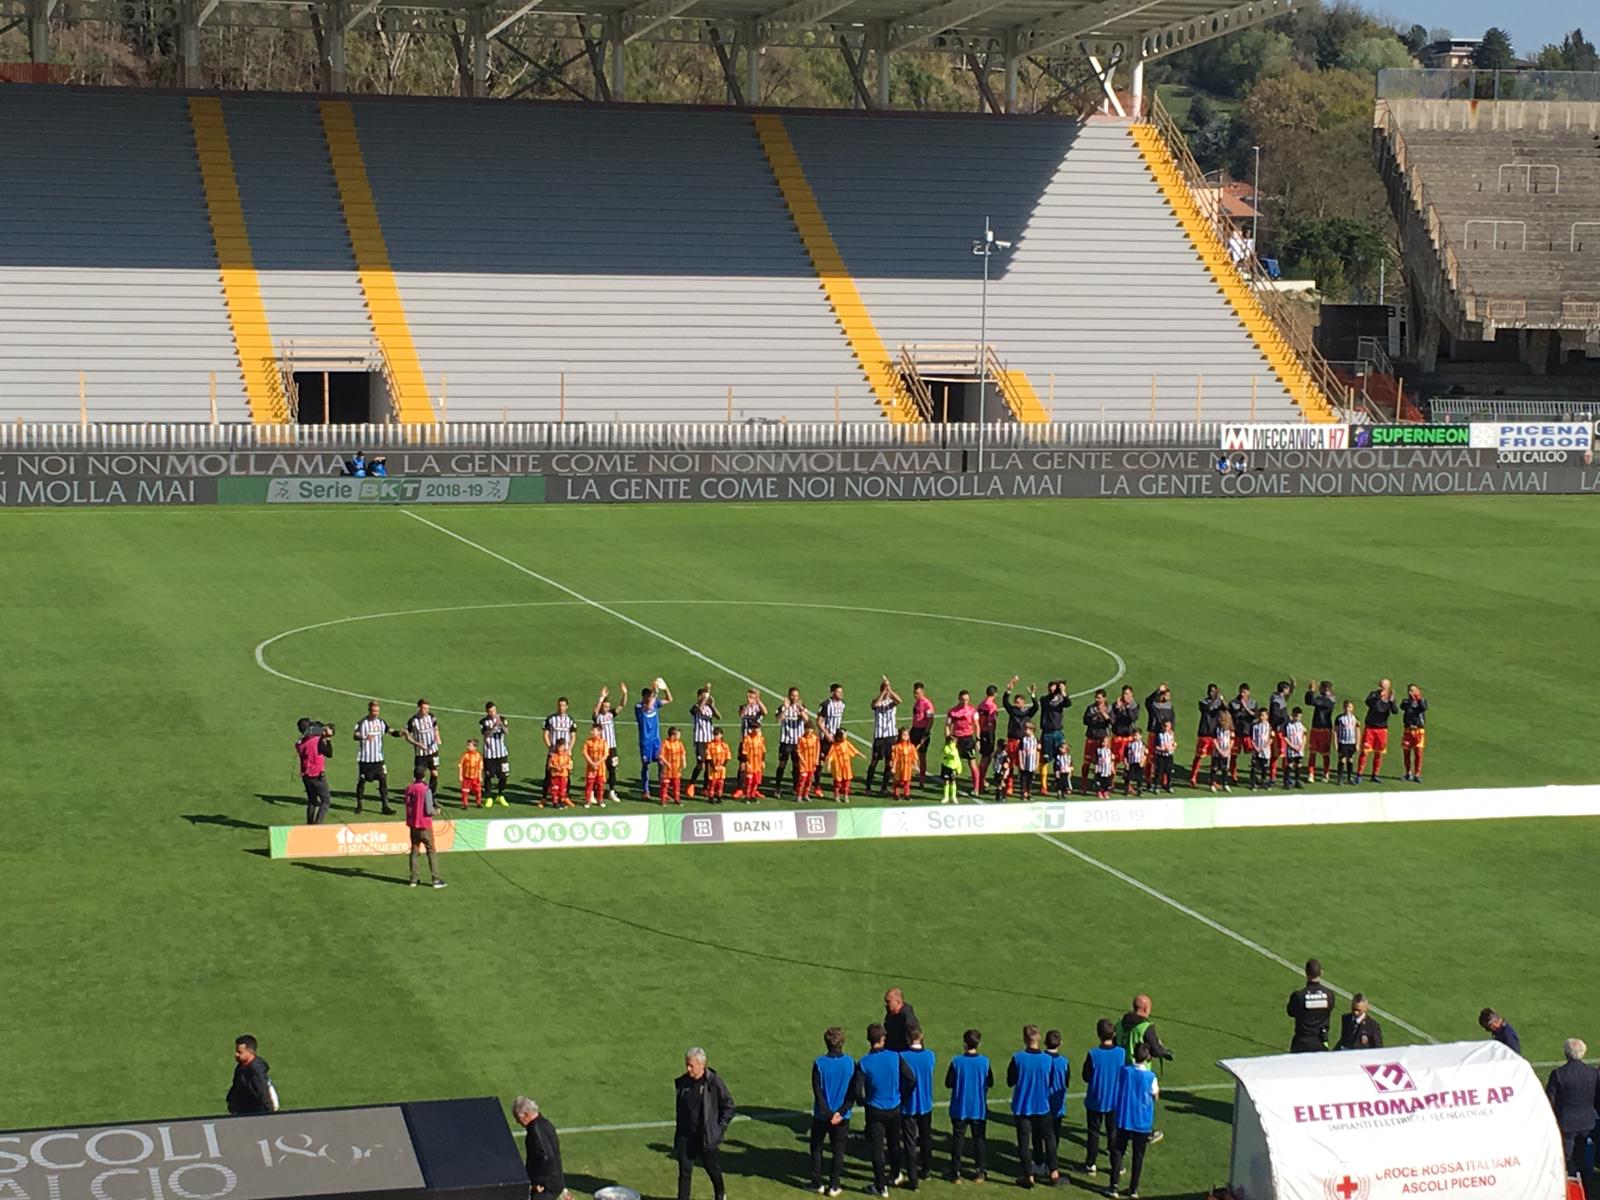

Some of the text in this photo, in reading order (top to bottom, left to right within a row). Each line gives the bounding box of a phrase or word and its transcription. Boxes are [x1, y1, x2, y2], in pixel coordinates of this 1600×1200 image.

[1253, 428, 1346, 449] MECCANICA H7
[1372, 428, 1469, 443] SUPERNEON
[1500, 426, 1588, 435] PICENA
[1500, 437, 1589, 447] FRIGOR
[17, 455, 76, 475] NOI
[403, 454, 441, 473] LA
[450, 454, 542, 473] GENTE
[551, 453, 638, 473] COME
[648, 453, 701, 472] NOI
[990, 452, 1024, 470] LA
[1031, 451, 1113, 470] GENTE
[1122, 451, 1198, 470] COME
[1522, 451, 1567, 463] CALCIO
[17, 480, 128, 503] MOLLA
[136, 480, 195, 502] MAI
[299, 479, 483, 501] Serie BKT 2018-19
[566, 475, 1062, 500] LA GENTE COME NOI NON MOLLA MAI
[1100, 471, 1549, 495] LA GENTE COME NOI NON MOLLA MAI
[733, 820, 771, 832] DAZN
[927, 808, 985, 830] Serie
[504, 821, 632, 843] UNIBET
[1294, 1085, 1514, 1123] ELETTROMARCHE AP
[1402, 1174, 1497, 1195] ASCOLI PICENO
